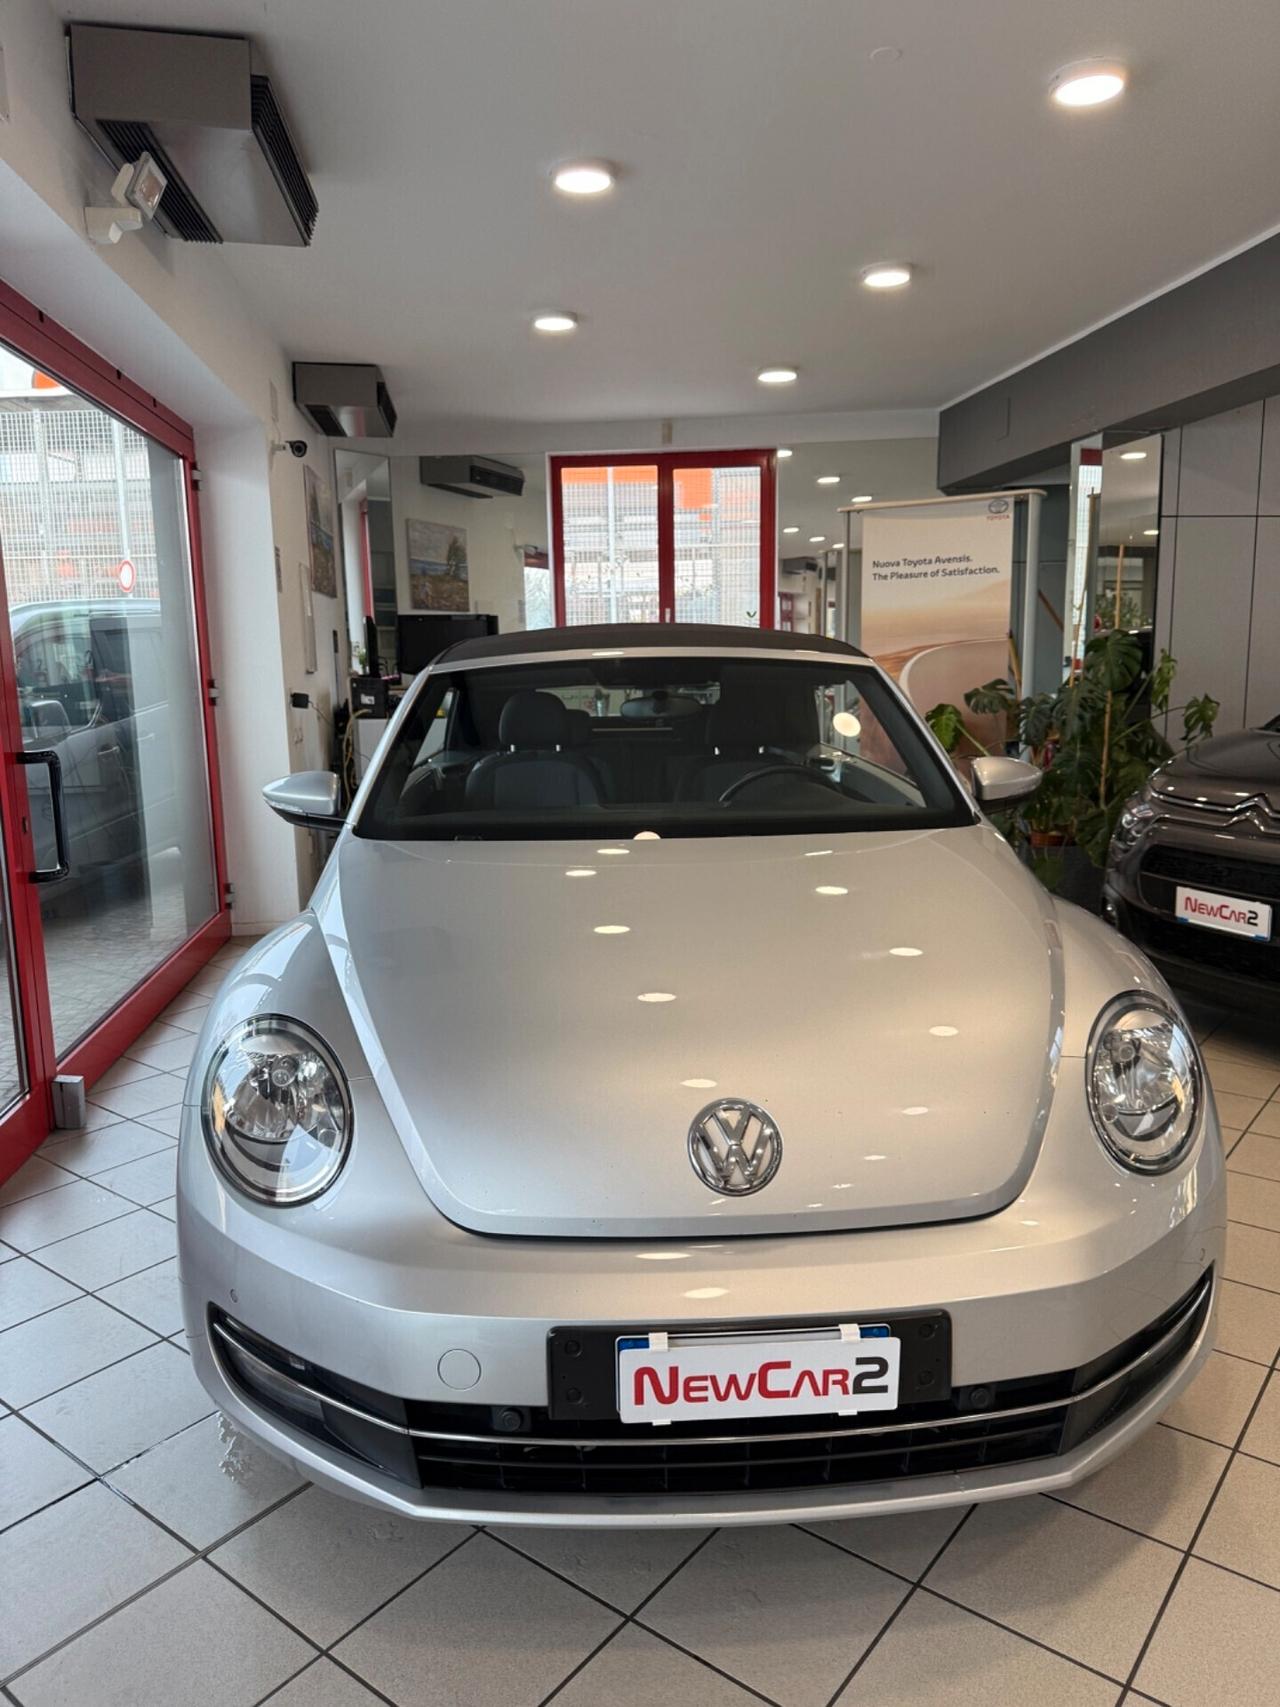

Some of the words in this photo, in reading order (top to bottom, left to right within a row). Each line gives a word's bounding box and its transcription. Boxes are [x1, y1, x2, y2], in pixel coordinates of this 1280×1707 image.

[872, 560, 900, 568] Nuova
[902, 558, 933, 568] Toyota
[934, 554, 973, 565] Avensis.
[872, 572, 889, 581] The
[890, 570, 928, 580] Pleasure
[930, 569, 940, 578] of
[941, 565, 1000, 577] Satisfaction.
